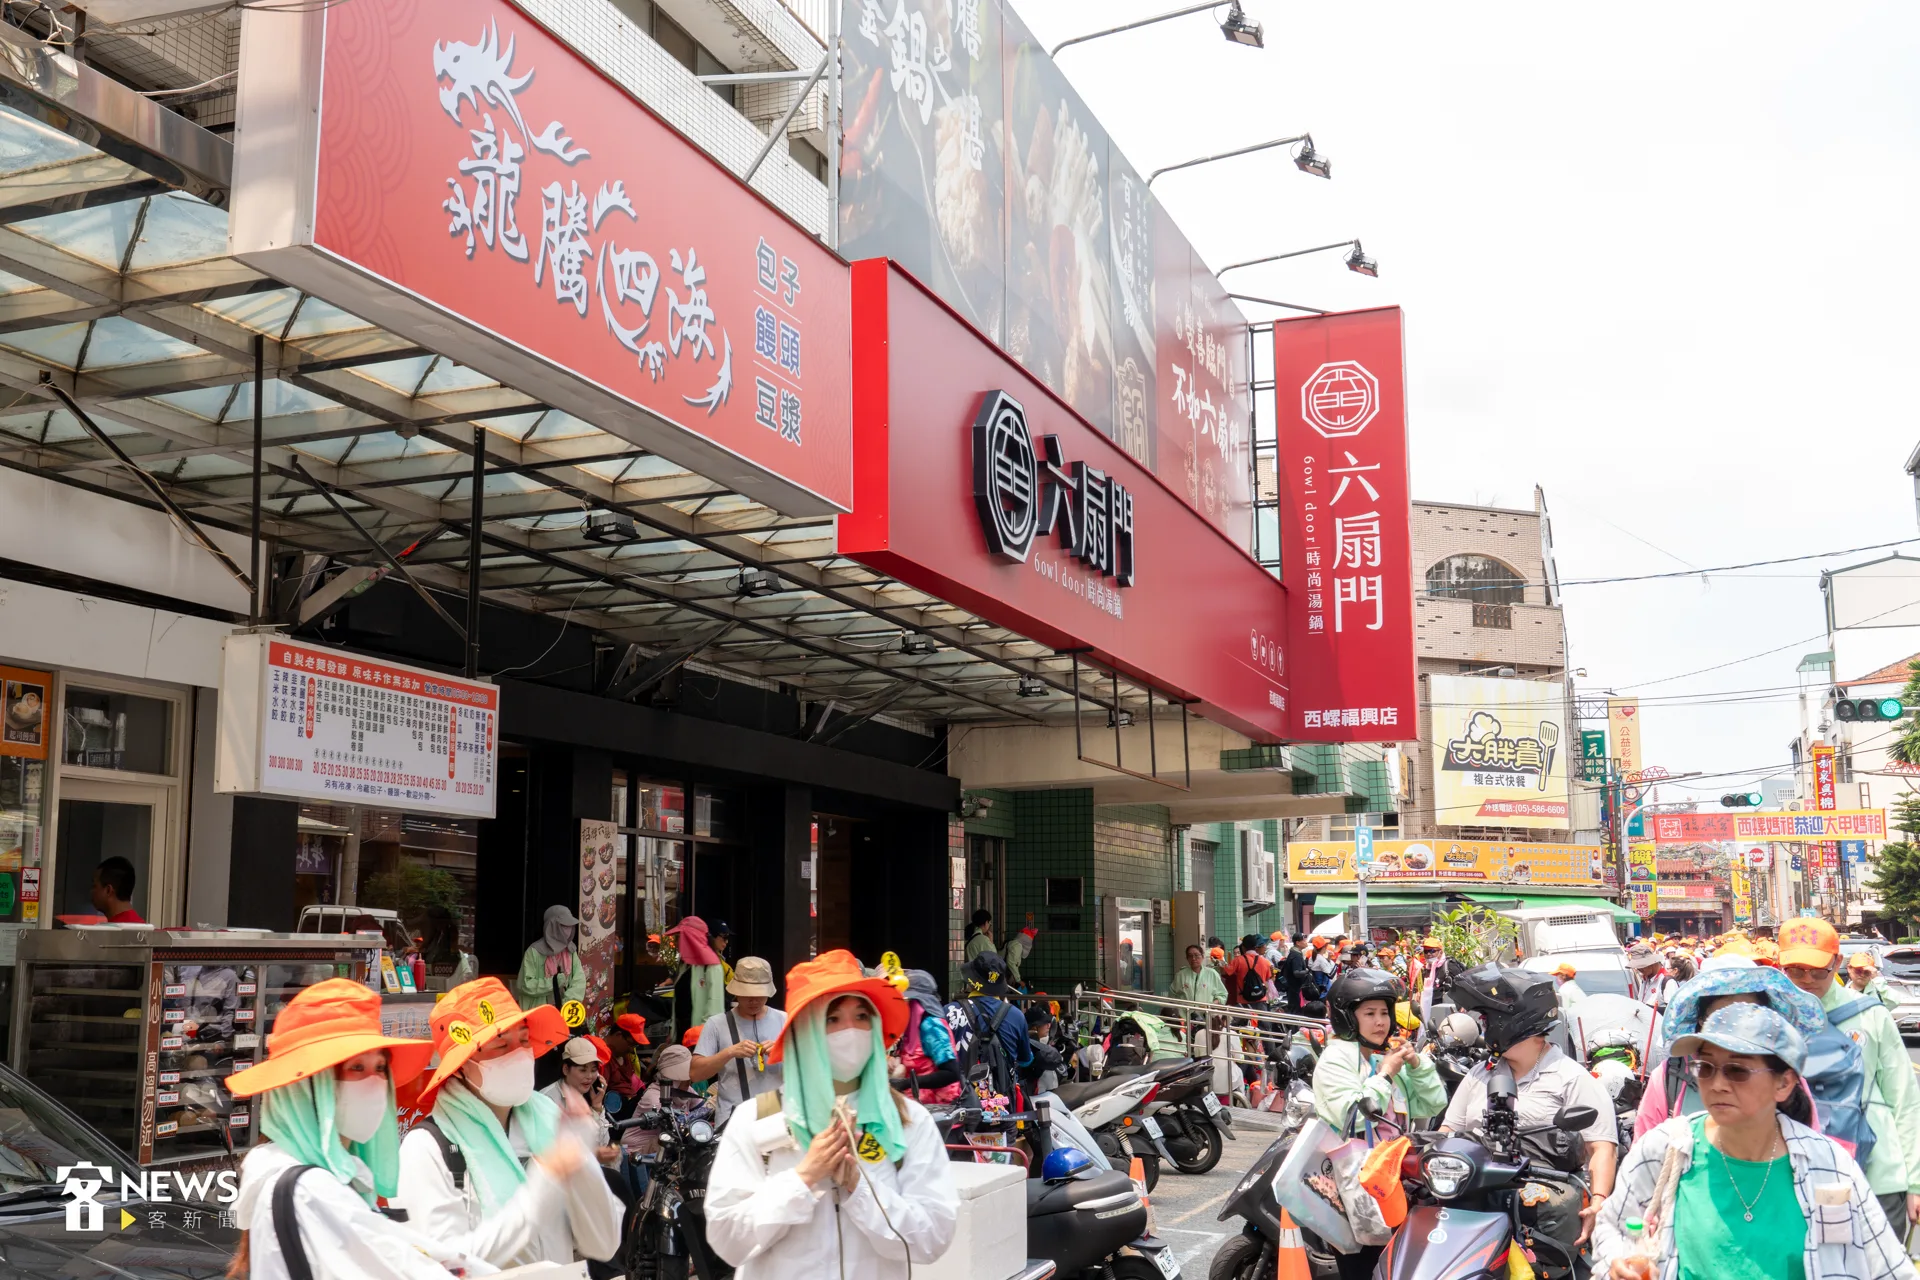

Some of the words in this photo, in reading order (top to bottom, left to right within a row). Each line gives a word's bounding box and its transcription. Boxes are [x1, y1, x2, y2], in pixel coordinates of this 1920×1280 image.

[442, 114, 717, 360] 龍騰四海
[1122, 172, 1135, 328] 百元鍋物
[755, 236, 801, 307] 包子
[755, 307, 801, 379] 饅頭
[755, 376, 802, 447] 豆漿
[1171, 362, 1240, 477] 不如六扇門
[1037, 434, 1135, 588] 六扇門
[1305, 503, 1315, 543] door
[1327, 450, 1384, 633] 六扇門
[1062, 567, 1084, 597] door
[1087, 577, 1122, 620] 時尚湯鍋
[1306, 549, 1324, 632] 時尚湯鍋
[283, 651, 347, 676] 自製老麵發酵
[352, 665, 421, 691] 原味手作無添加
[271, 669, 280, 721] 玉米水餃
[297, 675, 306, 738] 高麗菜水餃
[306, 683, 315, 732] 冷凍水餃
[315, 678, 323, 723] 抹茶紅豆
[9, 731, 36, 743] 起司饅頭
[1304, 706, 1398, 729] 西螺福興店
[1452, 737, 1543, 768] 大胖貴
[1586, 734, 1603, 758] 一元
[1620, 726, 1632, 769] 公益彩券
[1473, 773, 1526, 788] 複合式快餐
[1359, 834, 1369, 857] P
[1736, 814, 1883, 836] 西螺媽祖恭迎大甲媽祖
[1302, 857, 1340, 867] 大胖貴
[1447, 852, 1474, 861] 大胖貴
[150, 977, 162, 1024] 小心
[565, 1002, 582, 1024] 勇
